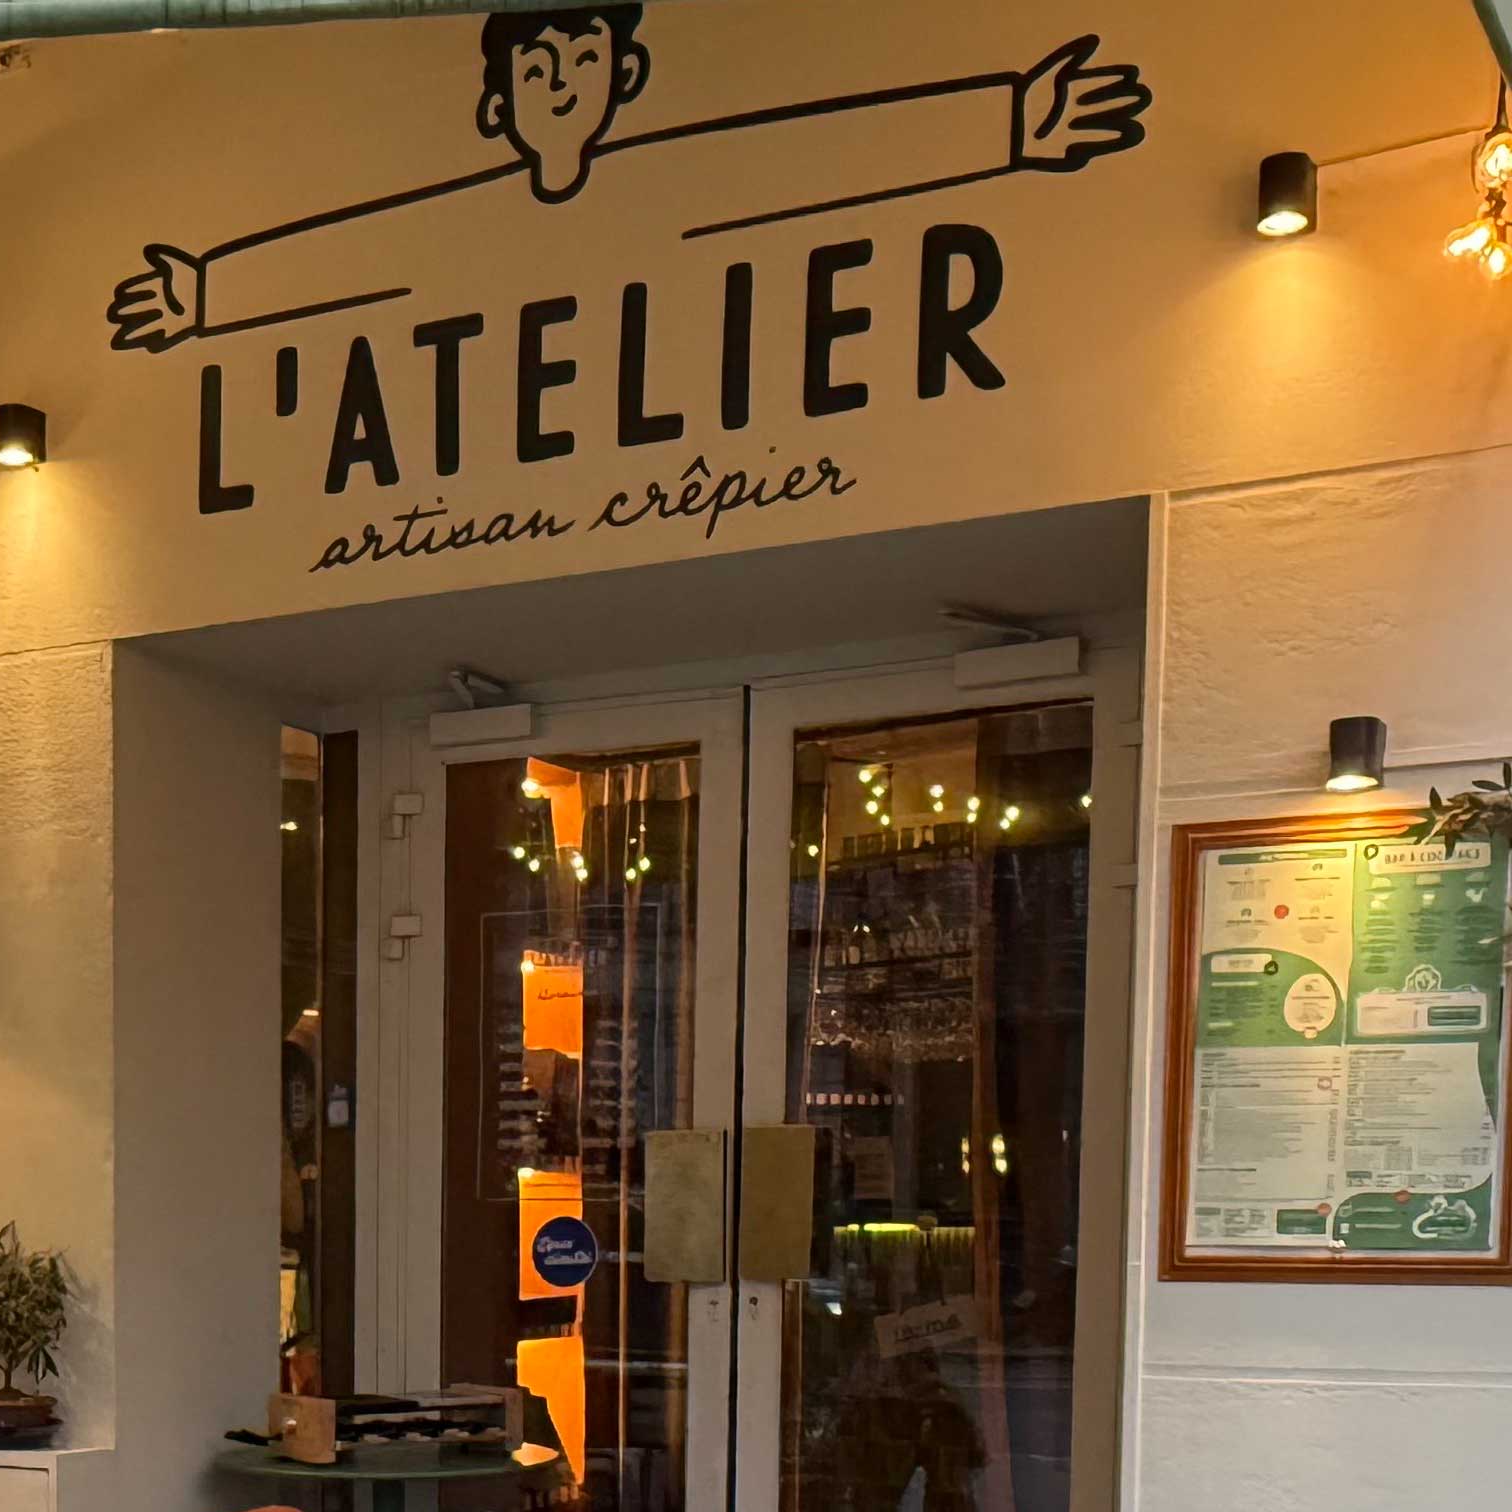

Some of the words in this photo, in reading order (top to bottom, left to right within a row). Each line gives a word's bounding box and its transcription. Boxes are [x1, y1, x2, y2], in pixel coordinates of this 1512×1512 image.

[198, 224, 1007, 514] L'ATELIER
[308, 496, 577, 573] artisan
[586, 446, 858, 540] crêpier
